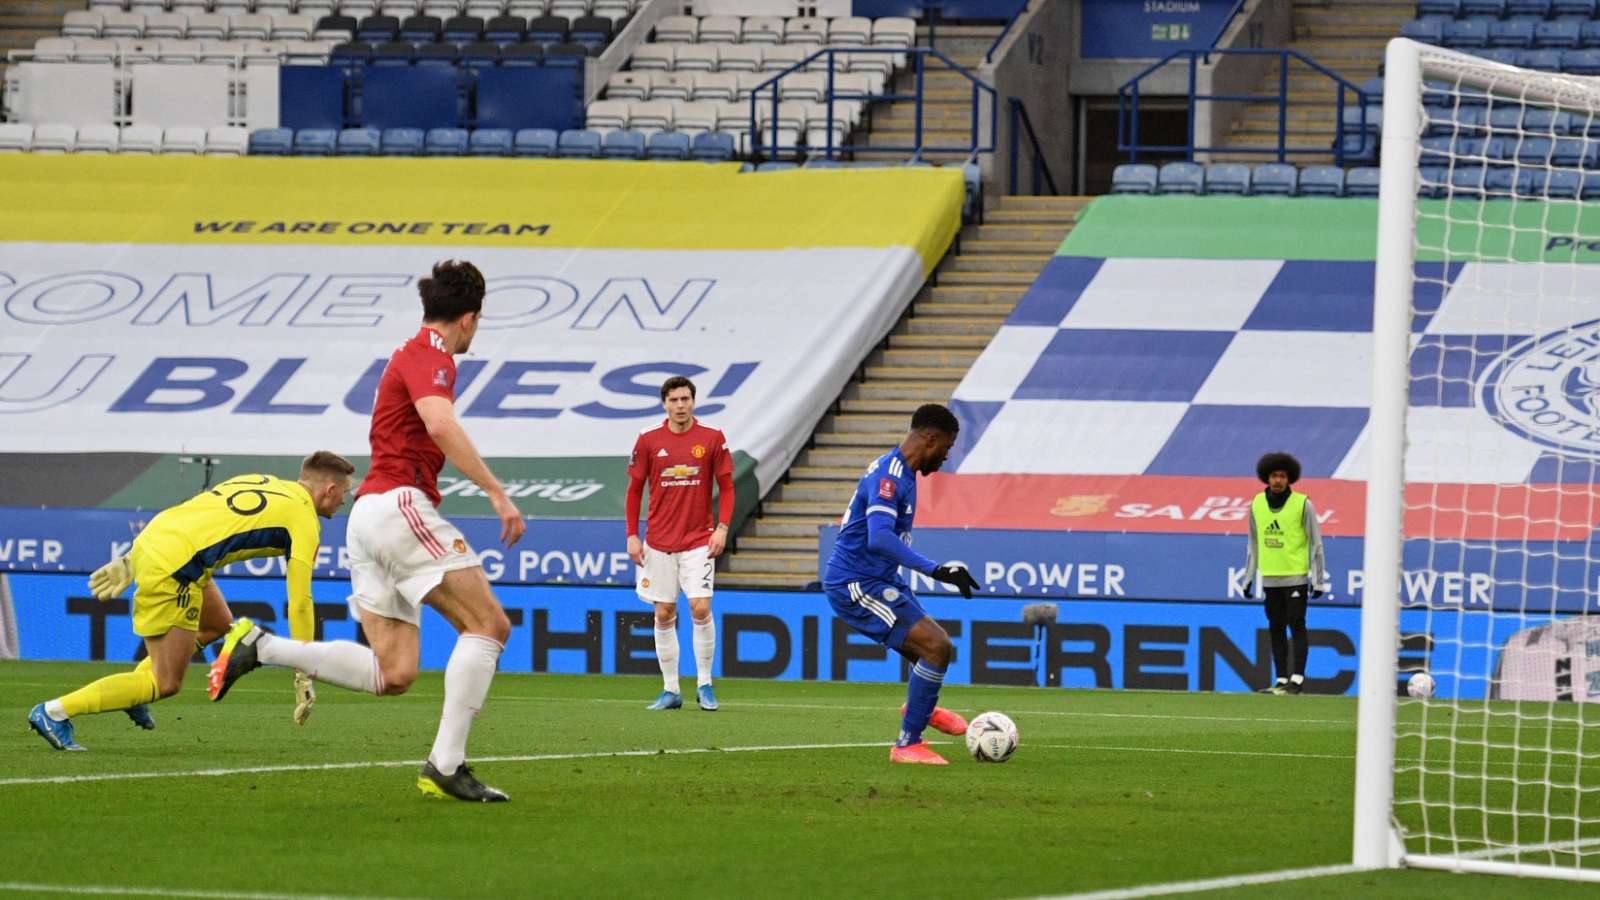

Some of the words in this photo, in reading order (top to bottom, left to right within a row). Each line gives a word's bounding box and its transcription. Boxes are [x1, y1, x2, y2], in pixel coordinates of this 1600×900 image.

[1144, 1, 1200, 13] STADIUM
[194, 221, 256, 233] WE
[260, 221, 337, 234] ARE
[347, 222, 433, 235] ONE
[441, 222, 551, 236] TEAM
[0, 270, 414, 328] OME
[478, 275, 717, 332] ON
[661, 479, 701, 487] CHEVROLET
[703, 562, 713, 581] 2
[985, 561, 1126, 596] POWER
[1347, 569, 1491, 604] PWER
